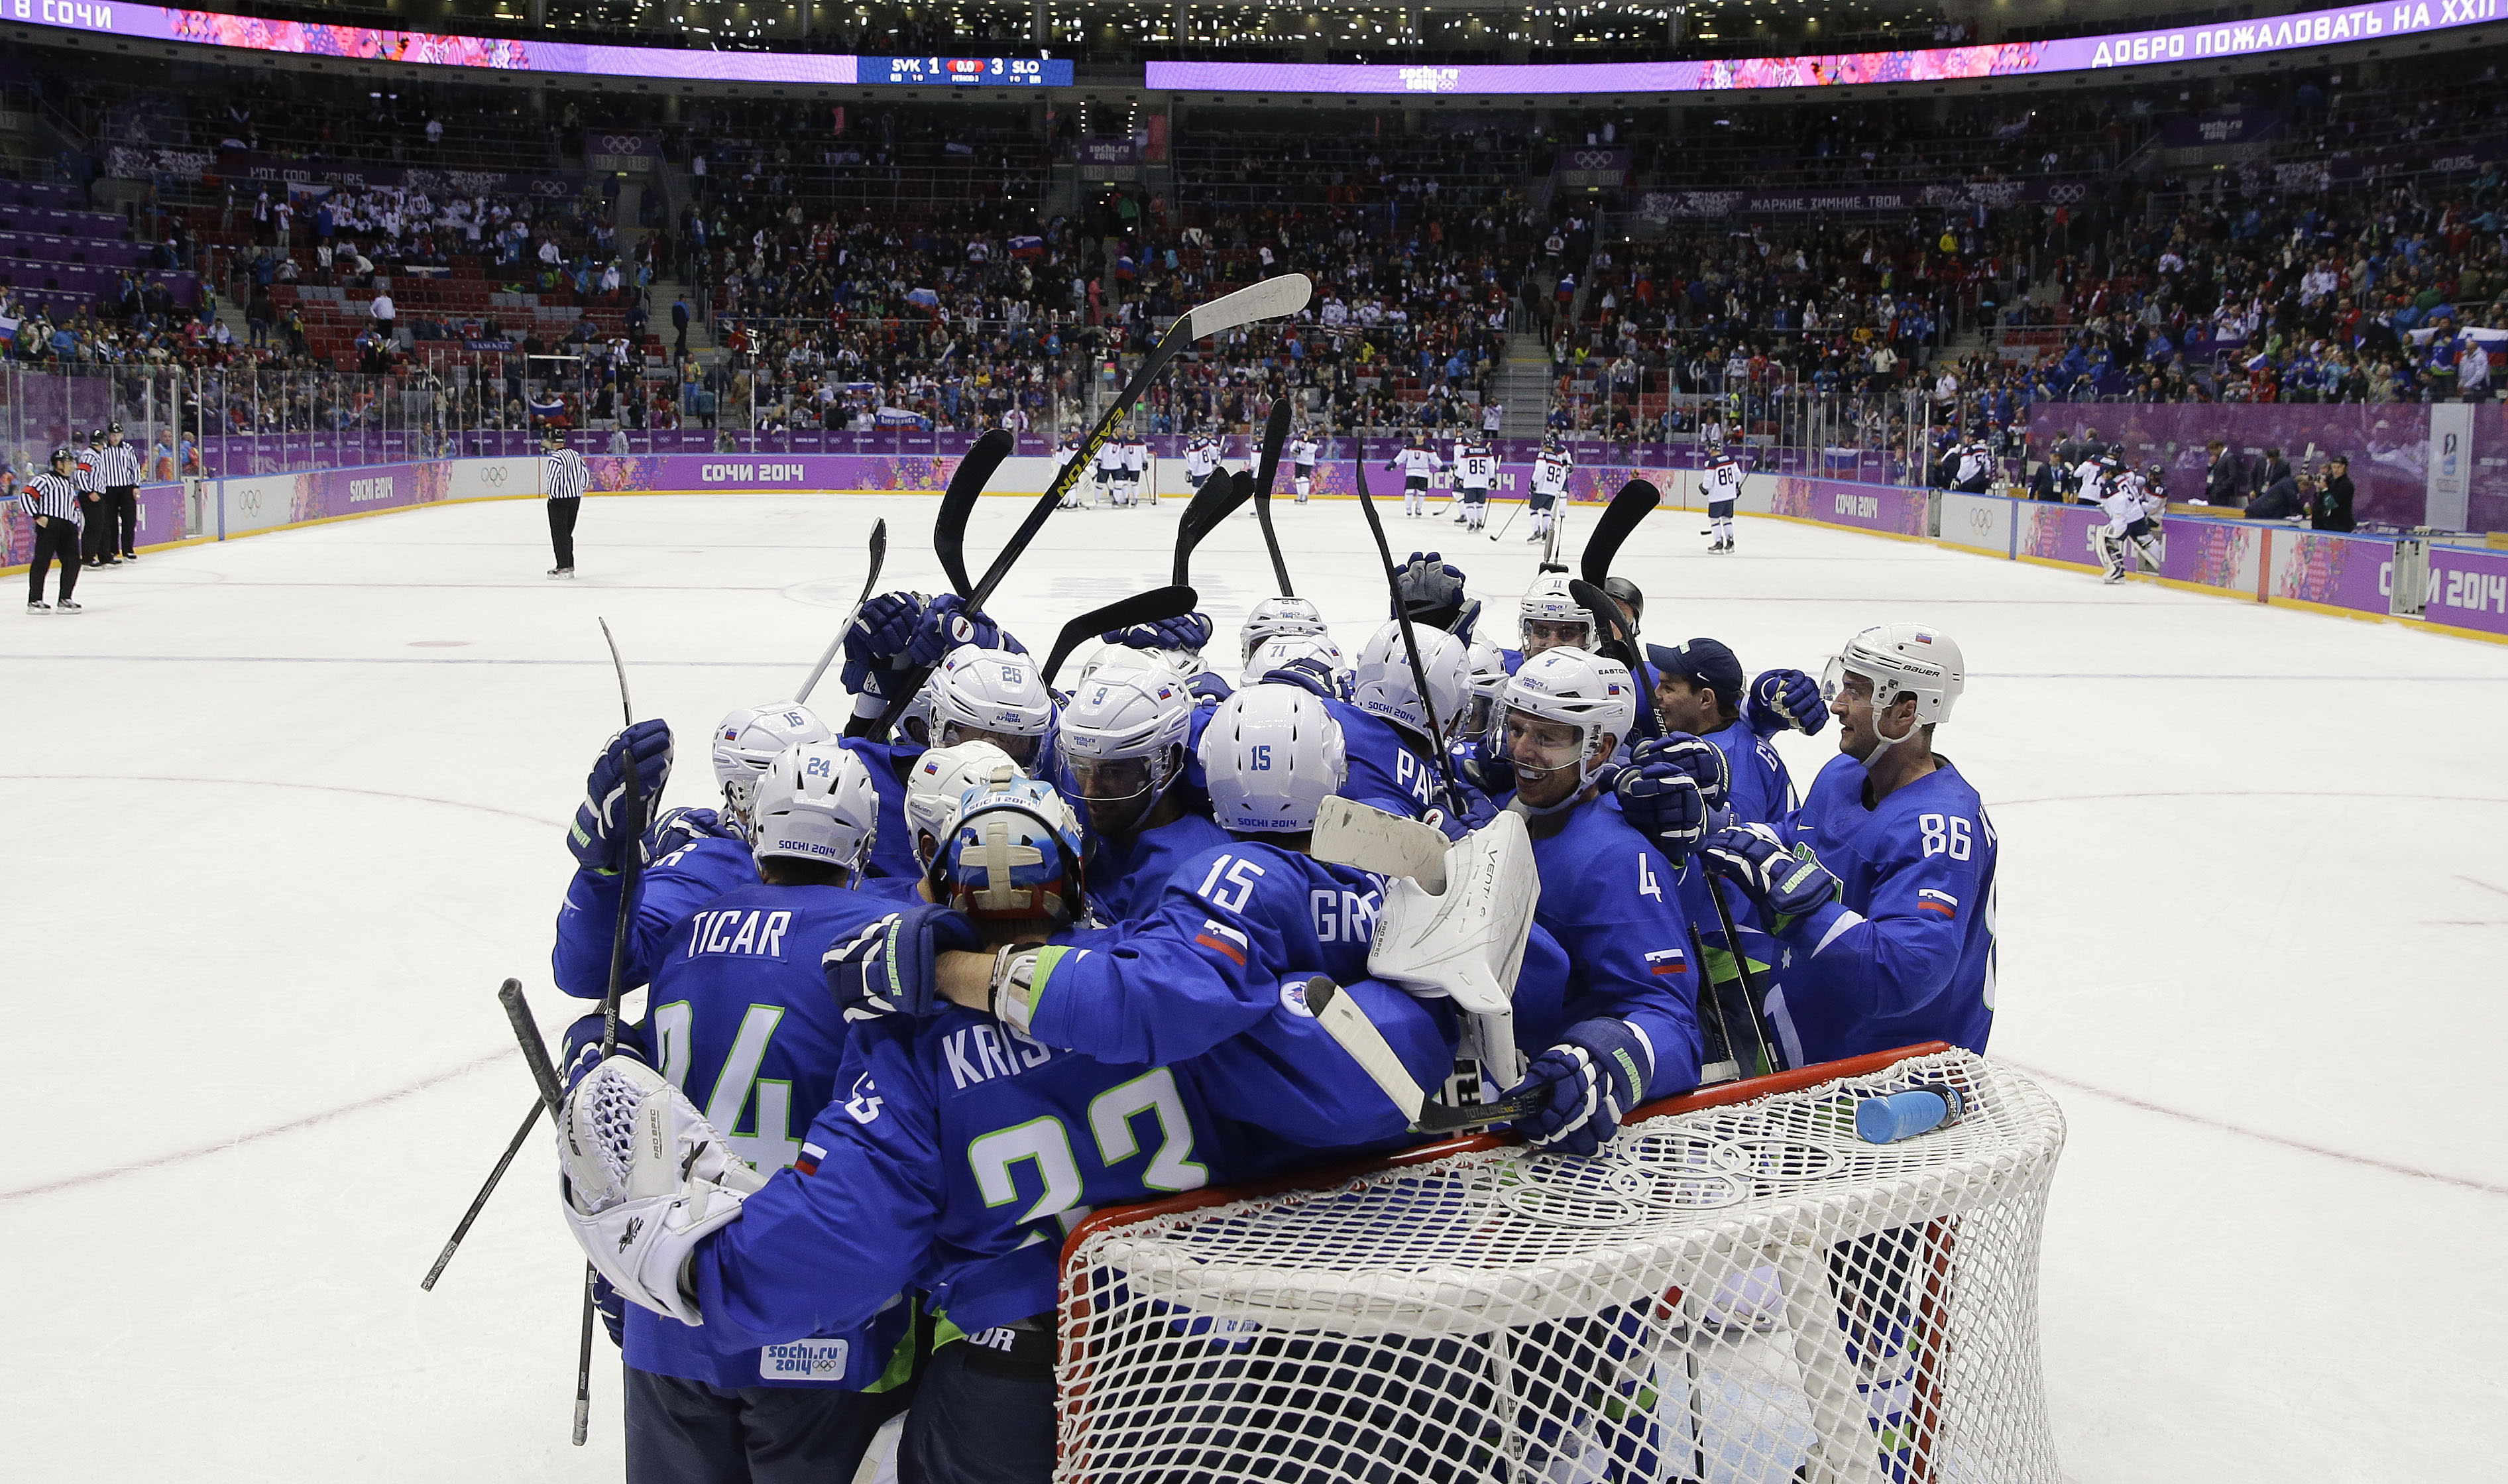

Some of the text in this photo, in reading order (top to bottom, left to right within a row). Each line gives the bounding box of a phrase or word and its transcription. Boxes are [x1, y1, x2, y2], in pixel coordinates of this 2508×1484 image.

[42, 0, 112, 29] СОЧИ
[2092, 34, 2185, 68] ДОБРО
[2195, 10, 2383, 55] ПОЖАЛОВАТЬ
[2393, 2, 2430, 31] НА
[891, 57, 1039, 75] SVK 1 0.0 3 SLO
[1089, 143, 1129, 153] sochi.ru
[1057, 407, 1124, 497] EASTON
[702, 464, 805, 482] СОЧИ 2014
[1469, 459, 1487, 475] 85
[1718, 467, 1733, 485] 88
[350, 477, 394, 502] SOCHI 2014
[1835, 493, 1878, 519] СОЧИ 2014
[2446, 569, 2507, 614] 2014
[1271, 645, 1286, 657] 71
[1545, 658, 1560, 667] 4
[1903, 665, 1941, 677] BAUER
[1001, 666, 1022, 684] 26
[866, 681, 876, 692] 14
[1092, 687, 1108, 705] 9
[783, 711, 804, 728] 16
[1368, 701, 1416, 723] SOCHI 2014
[807, 757, 830, 777] 24
[1251, 746, 1271, 770] 15
[968, 796, 1001, 811] SOCI
[1238, 819, 1297, 828] SOCHI 2014
[1919, 814, 1972, 861] 86
[779, 839, 836, 857] SOCHI 2014
[1197, 854, 1265, 915] 15
[1638, 852, 1662, 903] 4
[688, 909, 793, 958] TICAR
[606, 1007, 617, 1045] BAUER
[942, 1021, 1053, 1090] KRIS
[654, 999, 803, 1170] 24
[1463, 1104, 1505, 1119] TOTALONE
[652, 1137, 661, 1159] PRO
[968, 1066, 1209, 1251] 33
[768, 1343, 839, 1359] sochi.ru
[776, 1359, 811, 1375] 2014
